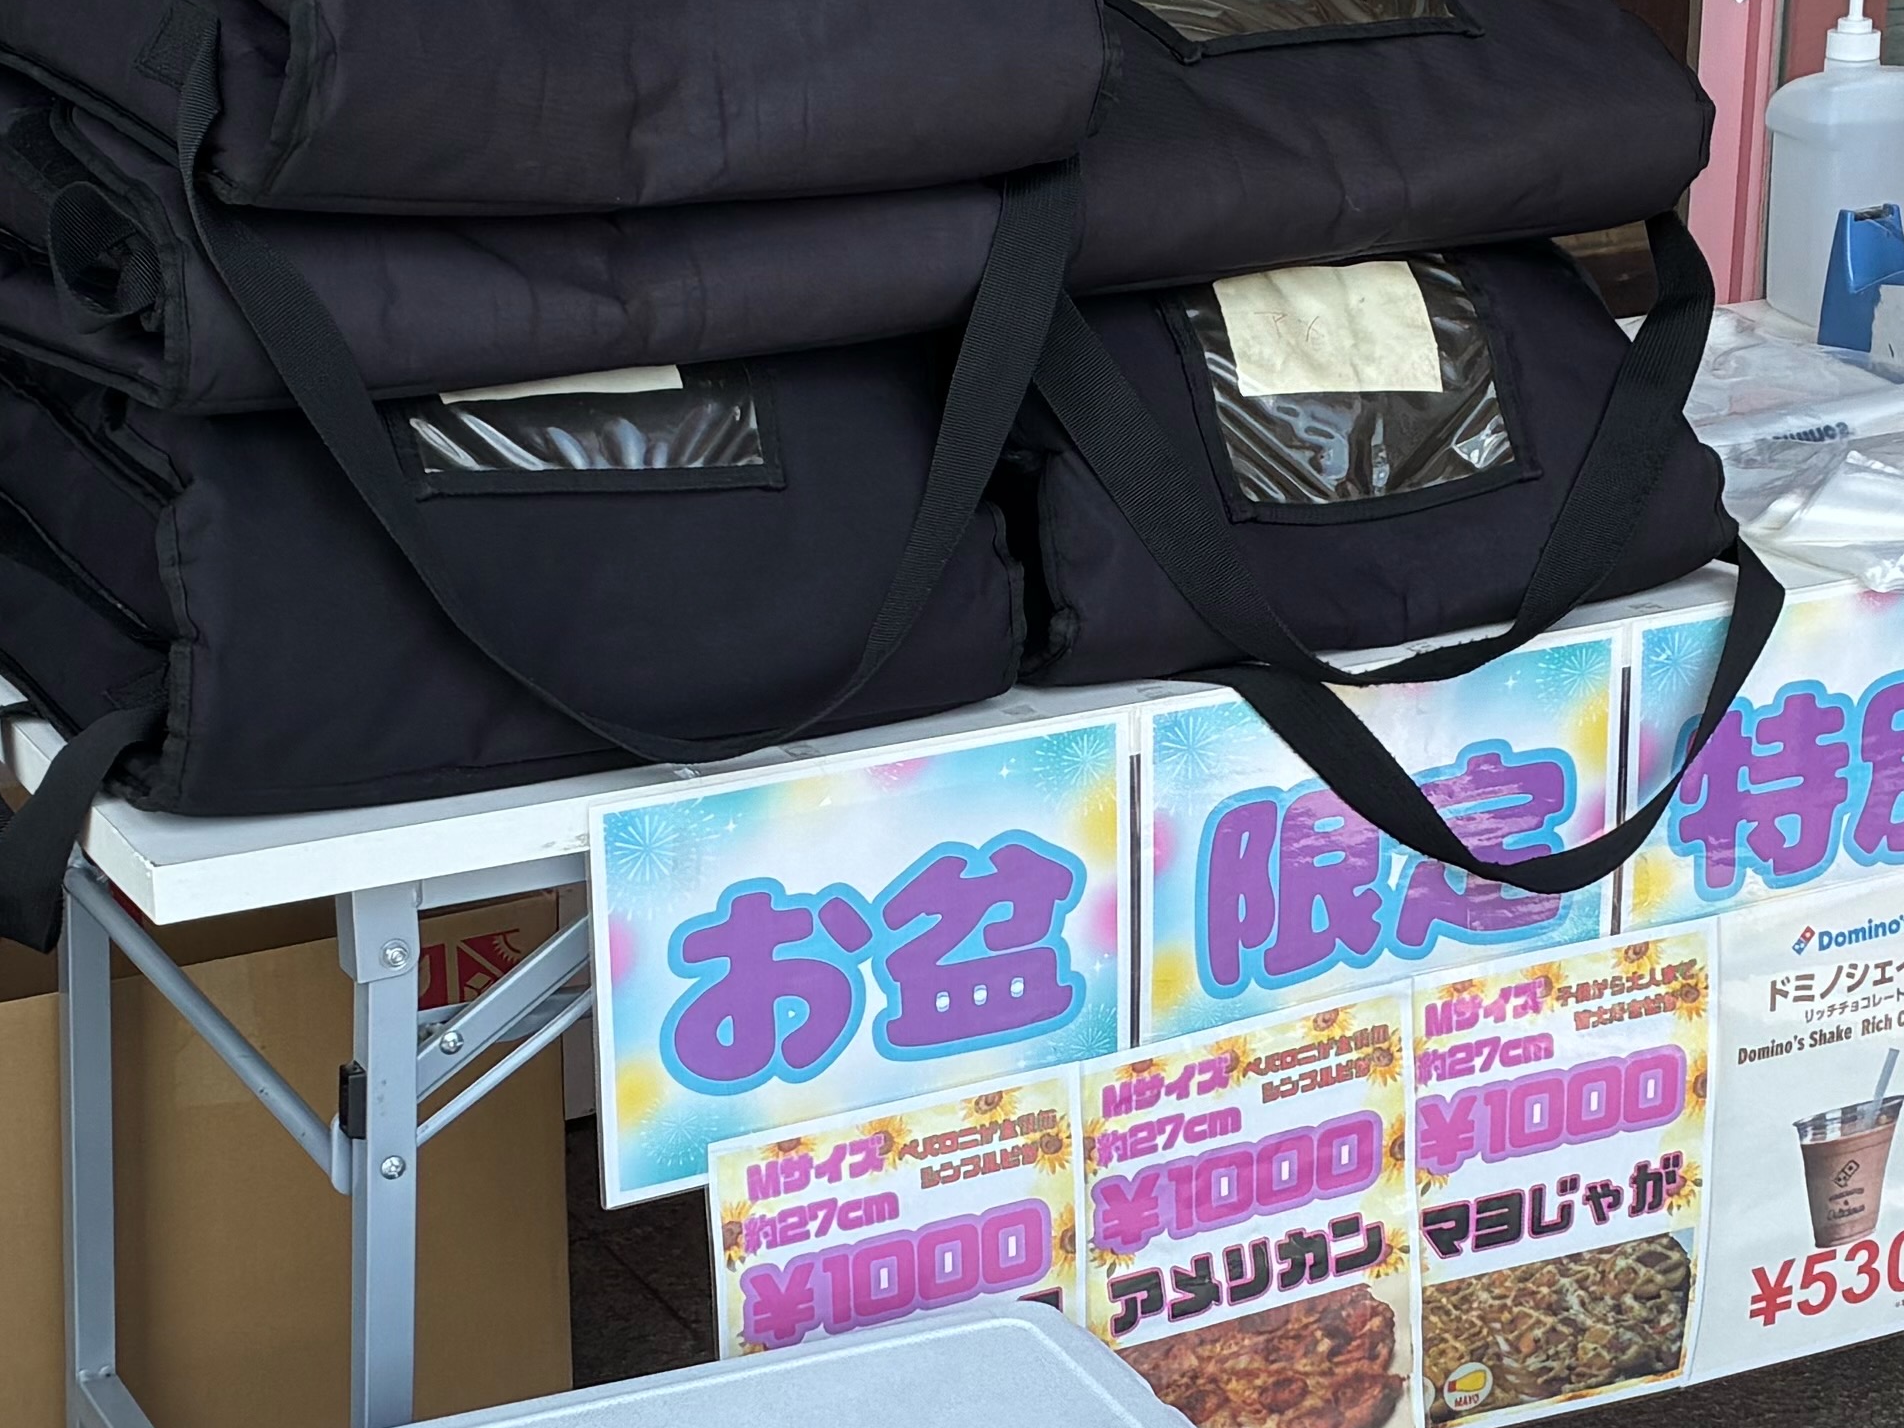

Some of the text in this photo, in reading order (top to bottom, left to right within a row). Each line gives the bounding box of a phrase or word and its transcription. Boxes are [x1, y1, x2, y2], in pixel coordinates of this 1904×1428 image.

[664, 833, 1089, 1091] お盆
[1197, 743, 1578, 998] 限定
[1424, 976, 1545, 1039] Mサイズ
[1805, 988, 1904, 1023] リッチチョコレート
[1416, 1033, 1554, 1086] 約27cm
[1737, 1035, 1805, 1064] Domino's
[1809, 1025, 1852, 1048] Shake
[1861, 1014, 1892, 1036] Rich
[1101, 1052, 1233, 1117] Mサイズ
[1416, 1044, 1686, 1174] ¥1000
[746, 1132, 887, 1200] Mサイズ
[1096, 1107, 1242, 1167] 約27cm
[1093, 1110, 1383, 1254] ¥1000
[1421, 1150, 1683, 1259] マヨじゃが
[743, 1191, 899, 1253] 約27cm
[740, 1199, 1052, 1349] ¥1000
[1108, 1212, 1385, 1336] アメリカン
